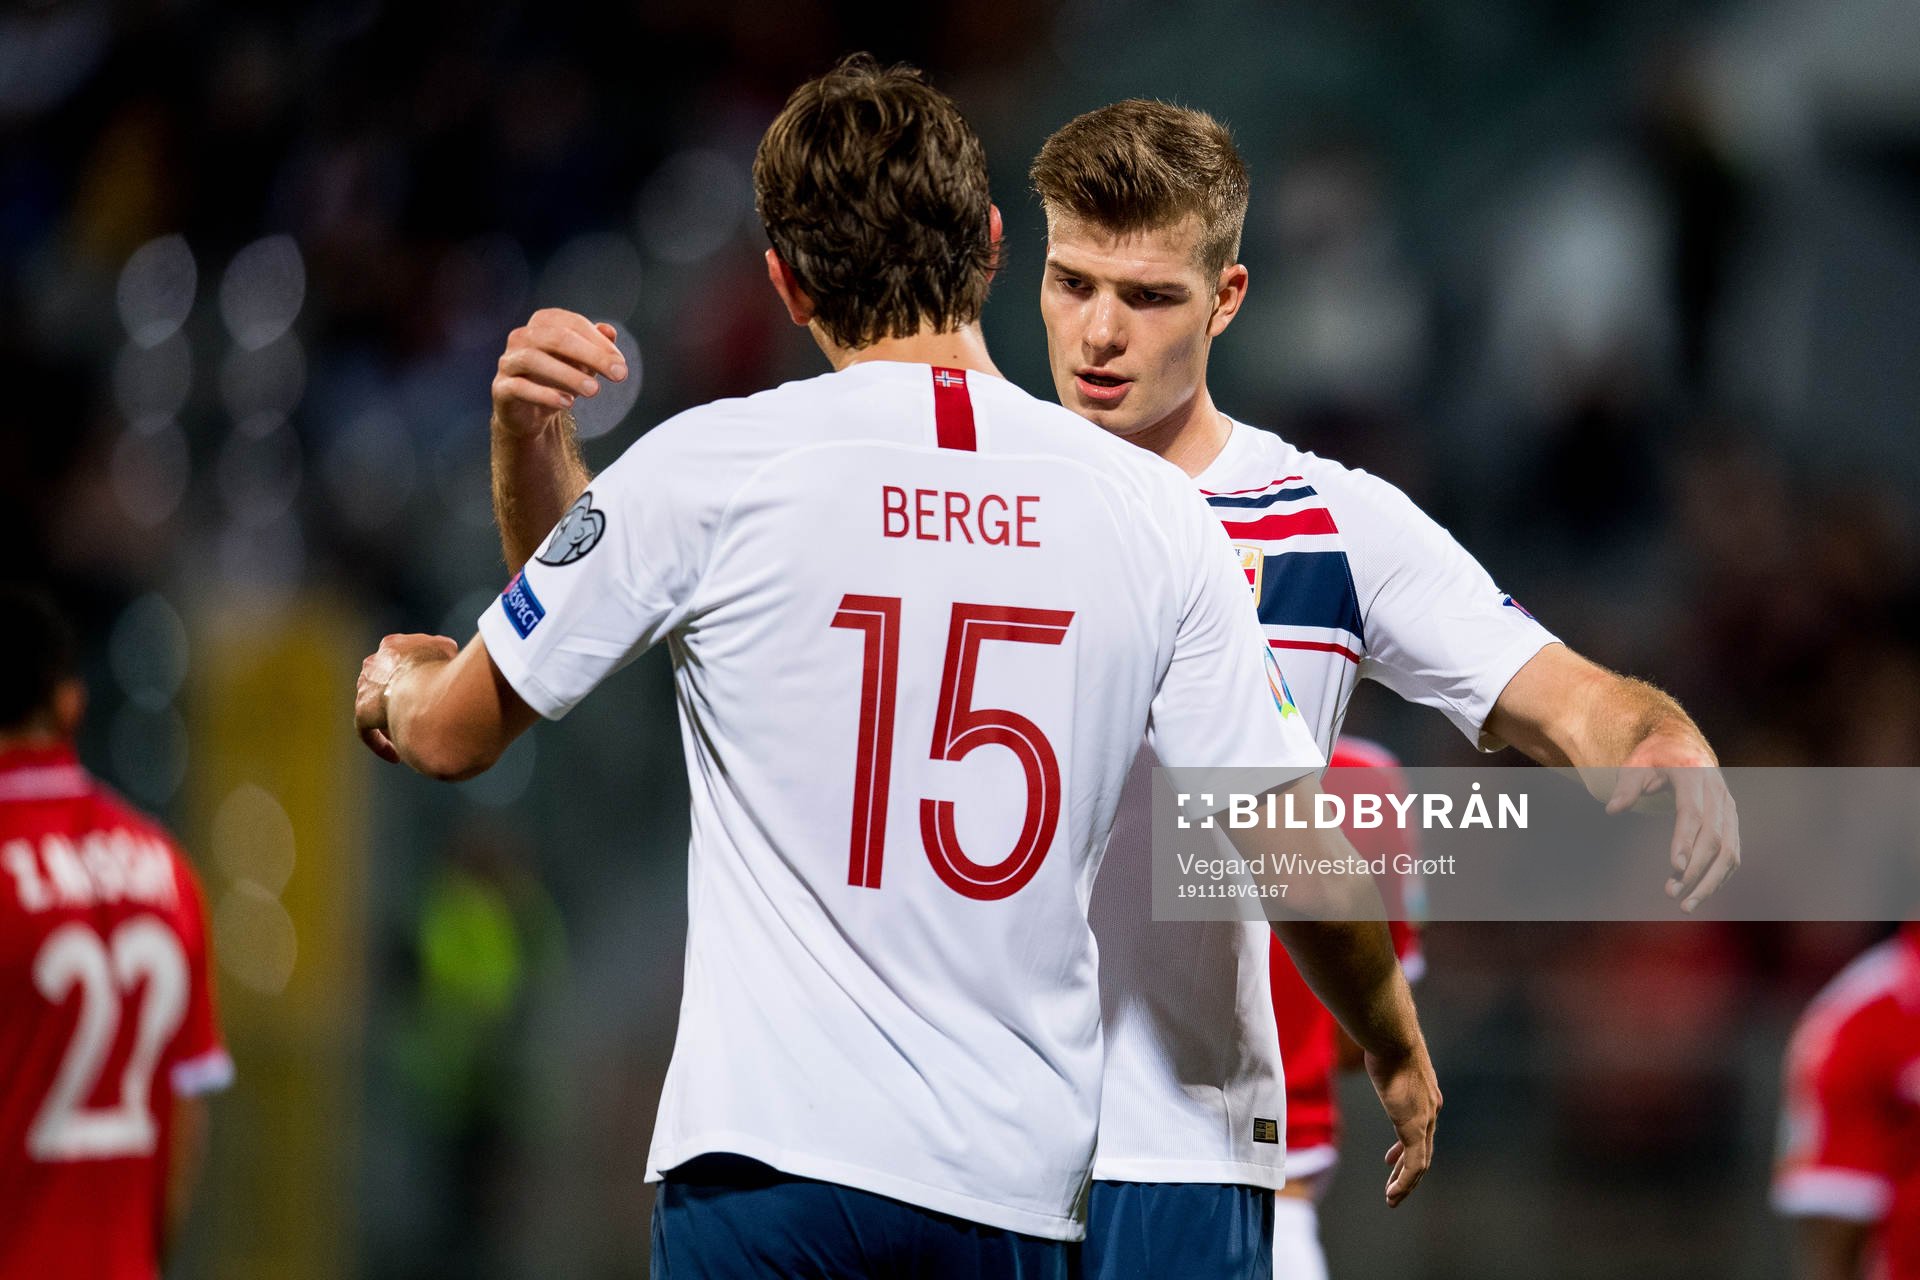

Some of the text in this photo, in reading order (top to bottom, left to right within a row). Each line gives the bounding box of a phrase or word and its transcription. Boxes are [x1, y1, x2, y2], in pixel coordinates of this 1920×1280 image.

[882, 485, 1041, 547] BERGE
[829, 593, 1076, 901] 15
[26, 914, 192, 1162] 22
